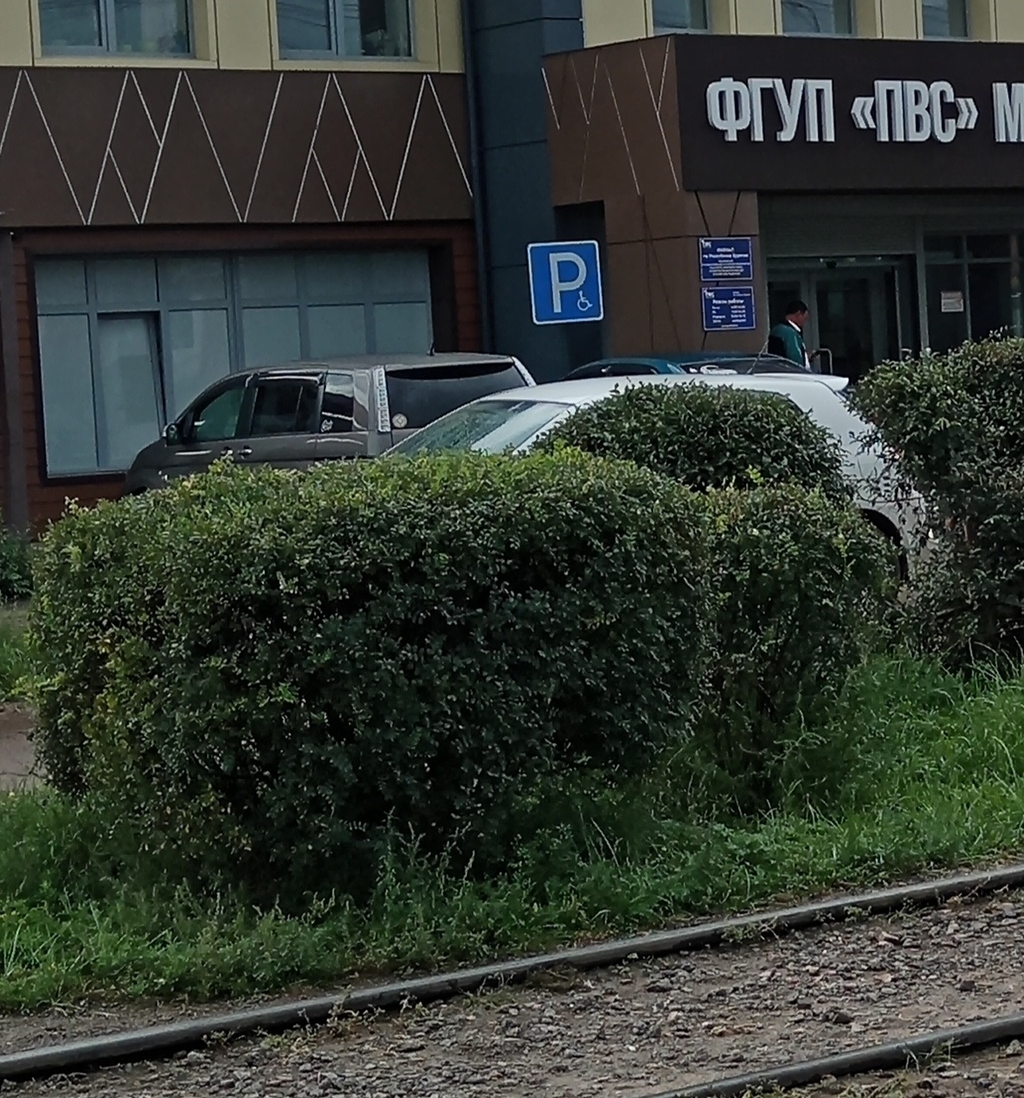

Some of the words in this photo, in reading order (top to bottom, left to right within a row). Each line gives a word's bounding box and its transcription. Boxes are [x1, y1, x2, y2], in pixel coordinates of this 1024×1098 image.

[706, 77, 835, 142] ФГУП
[850, 79, 979, 143] «ПВС»
[549, 252, 587, 313] P
